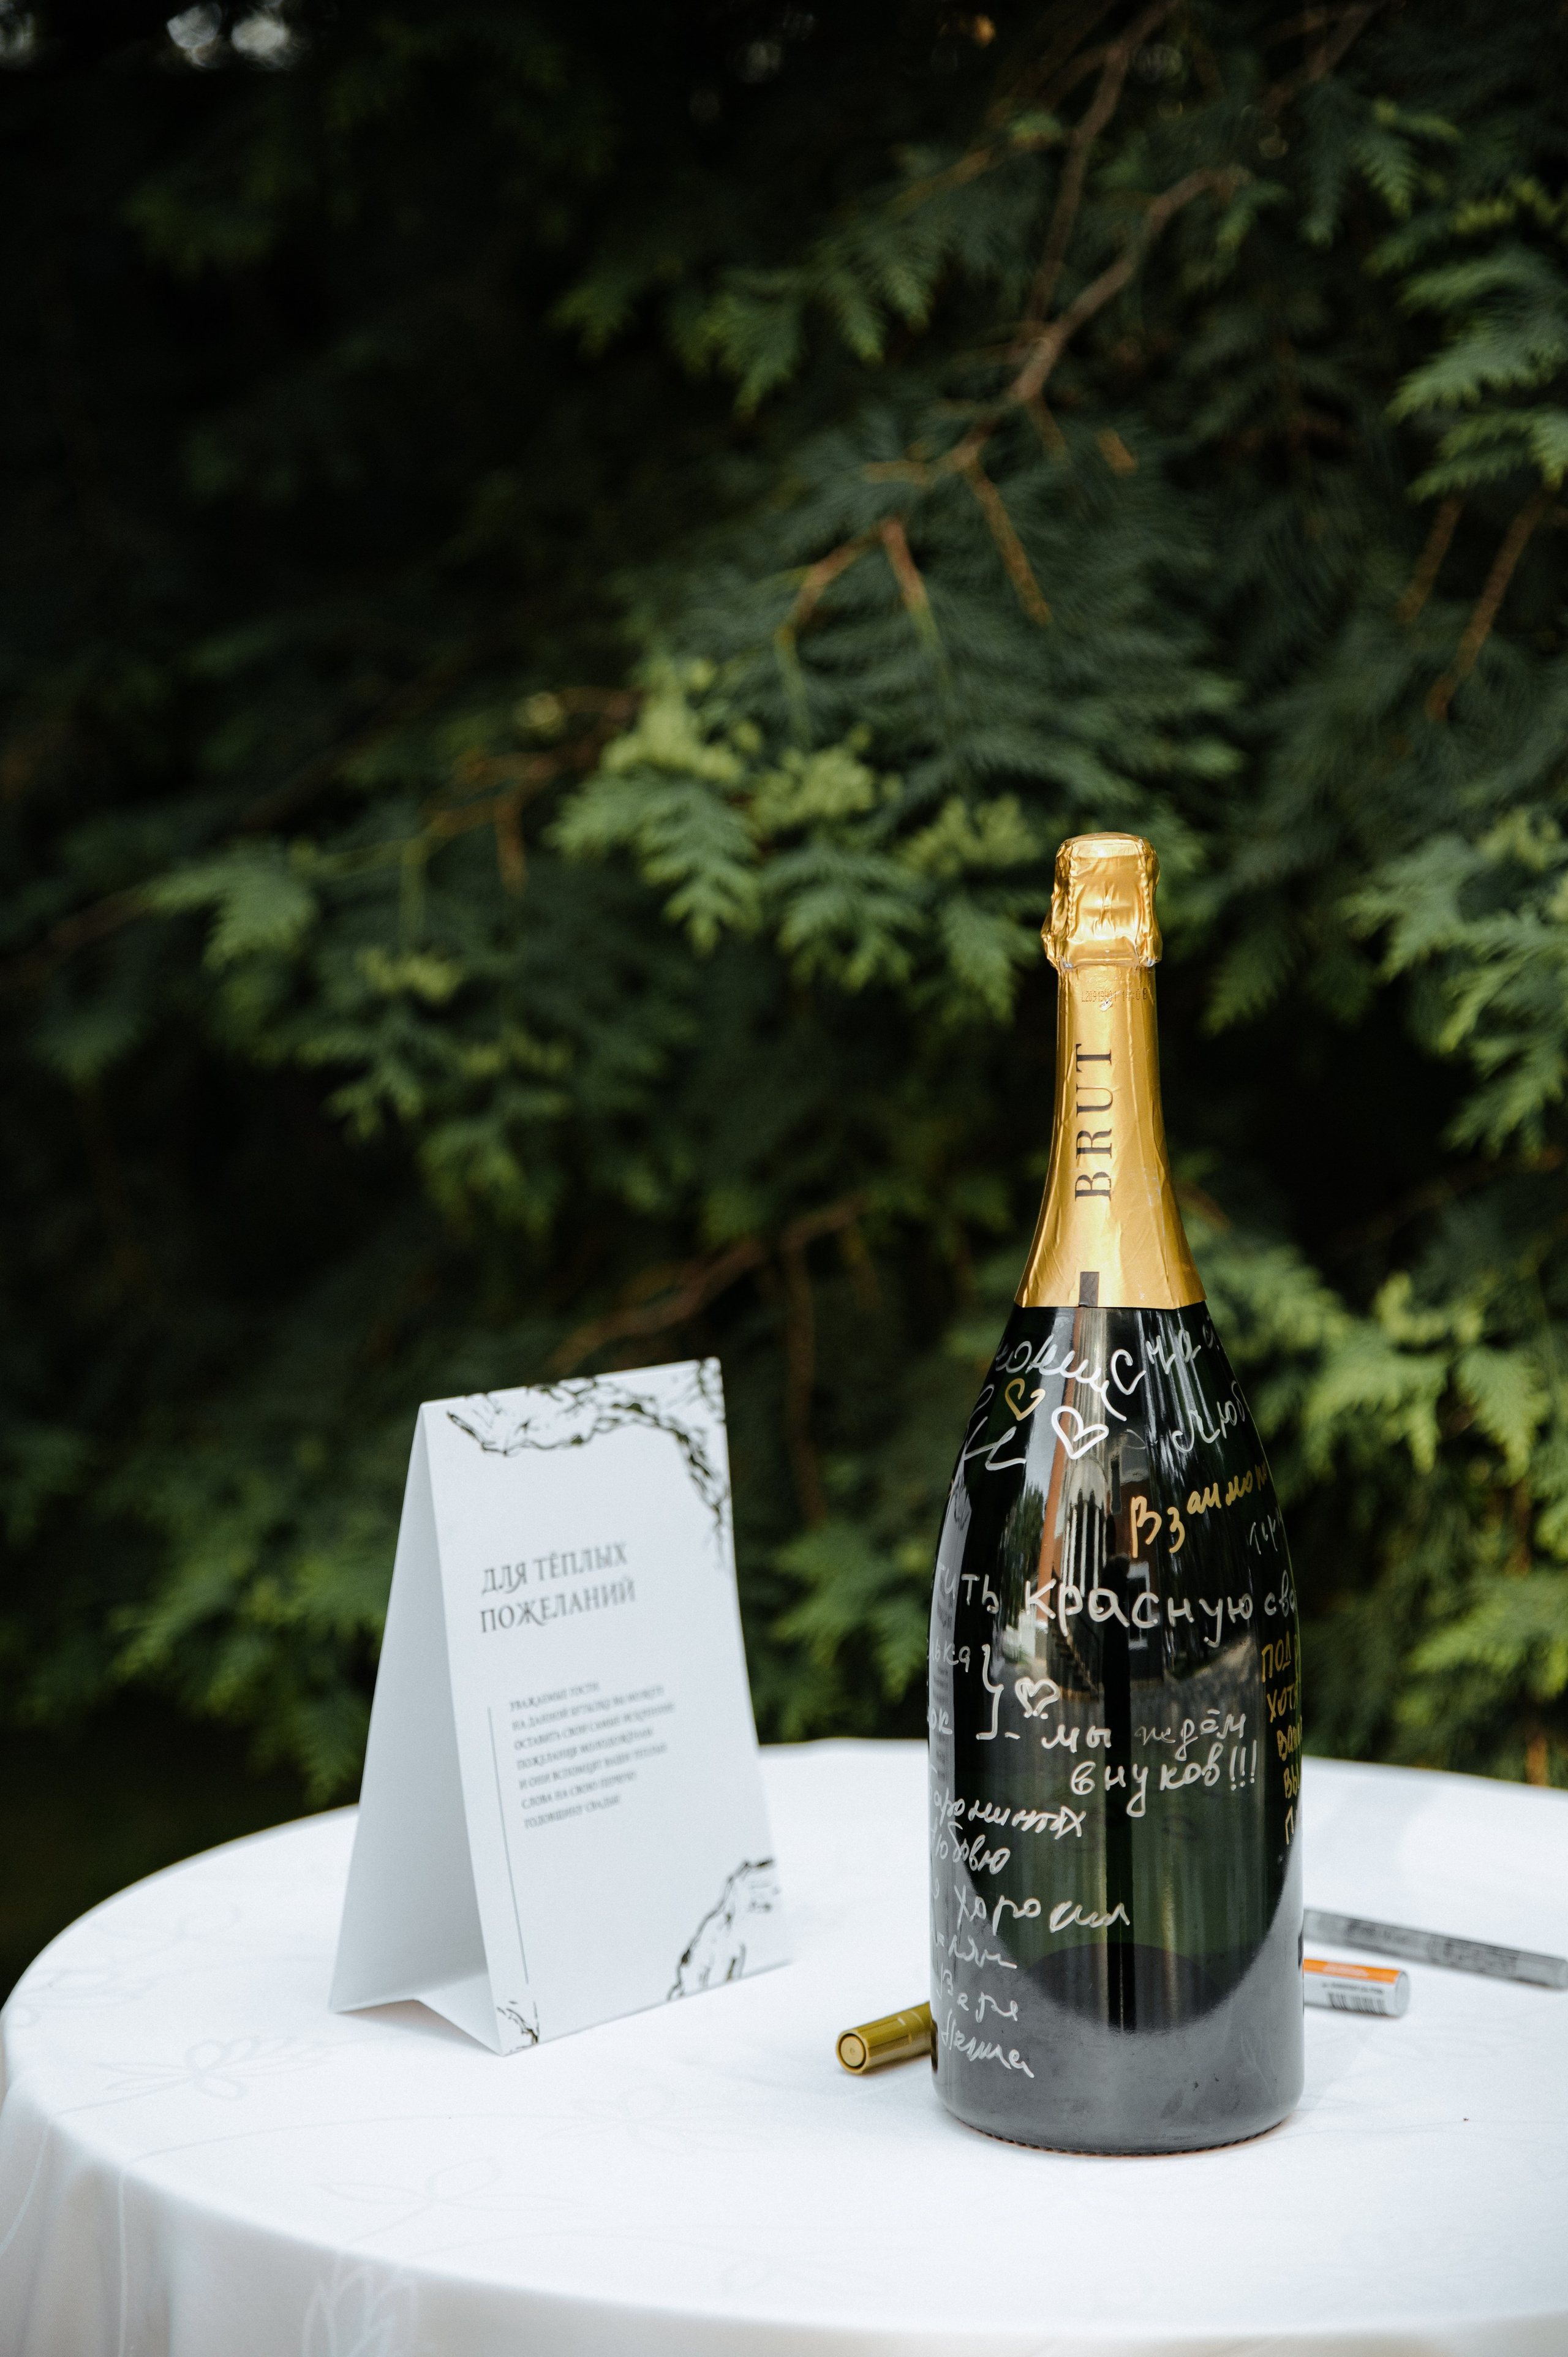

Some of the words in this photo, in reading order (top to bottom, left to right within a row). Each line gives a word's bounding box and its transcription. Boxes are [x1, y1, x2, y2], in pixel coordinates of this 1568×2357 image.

[1075, 1043, 1114, 1202] BRUT
[481, 1561, 528, 1594] ДЛЯ
[532, 1541, 627, 1582] ТЁПЛЫХ
[480, 1575, 635, 1633] ПОЖЕЛАНИЙ
[1041, 1724, 1112, 1753] мы
